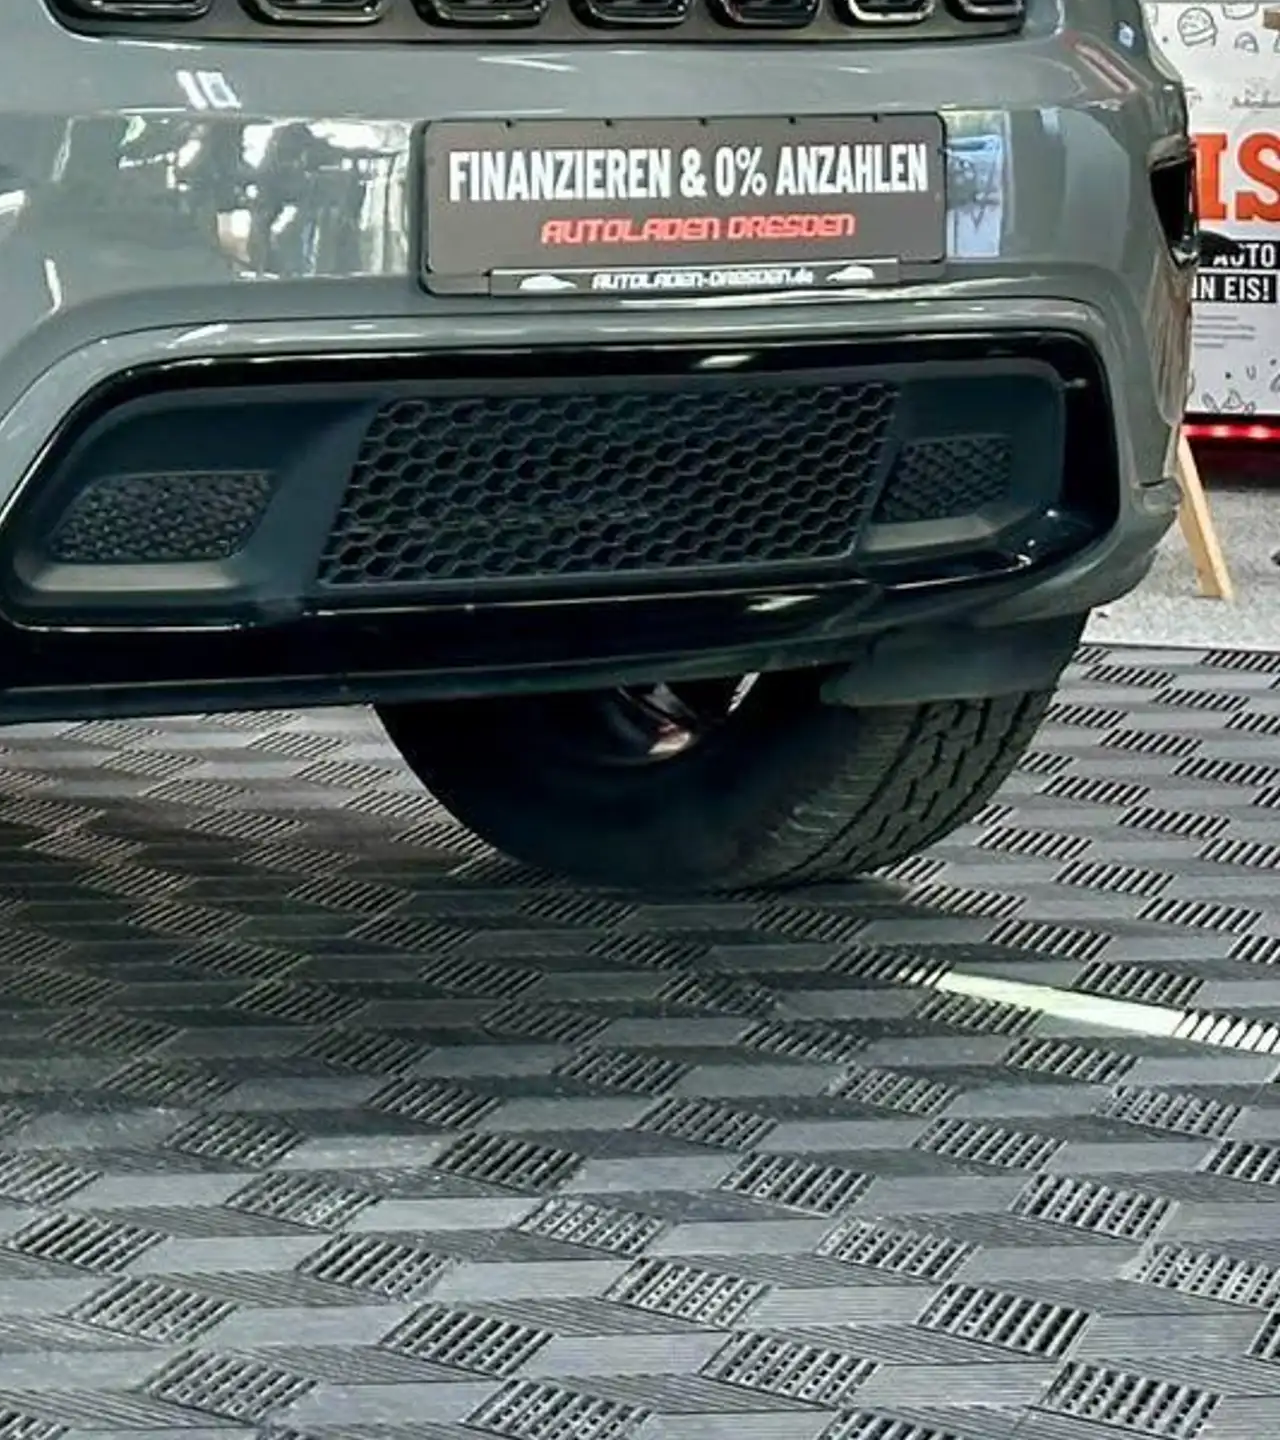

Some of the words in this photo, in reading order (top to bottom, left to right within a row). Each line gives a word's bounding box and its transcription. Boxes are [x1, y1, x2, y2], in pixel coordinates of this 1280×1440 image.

[448, 147, 672, 202] FINANZIEREN
[679, 147, 708, 198] &
[715, 145, 768, 198] 0%
[775, 143, 929, 196] ANZAHLEN
[541, 216, 721, 244] AUTOLADEN
[727, 213, 856, 239] DRESDEN
[1224, 275, 1270, 301] EIS!
